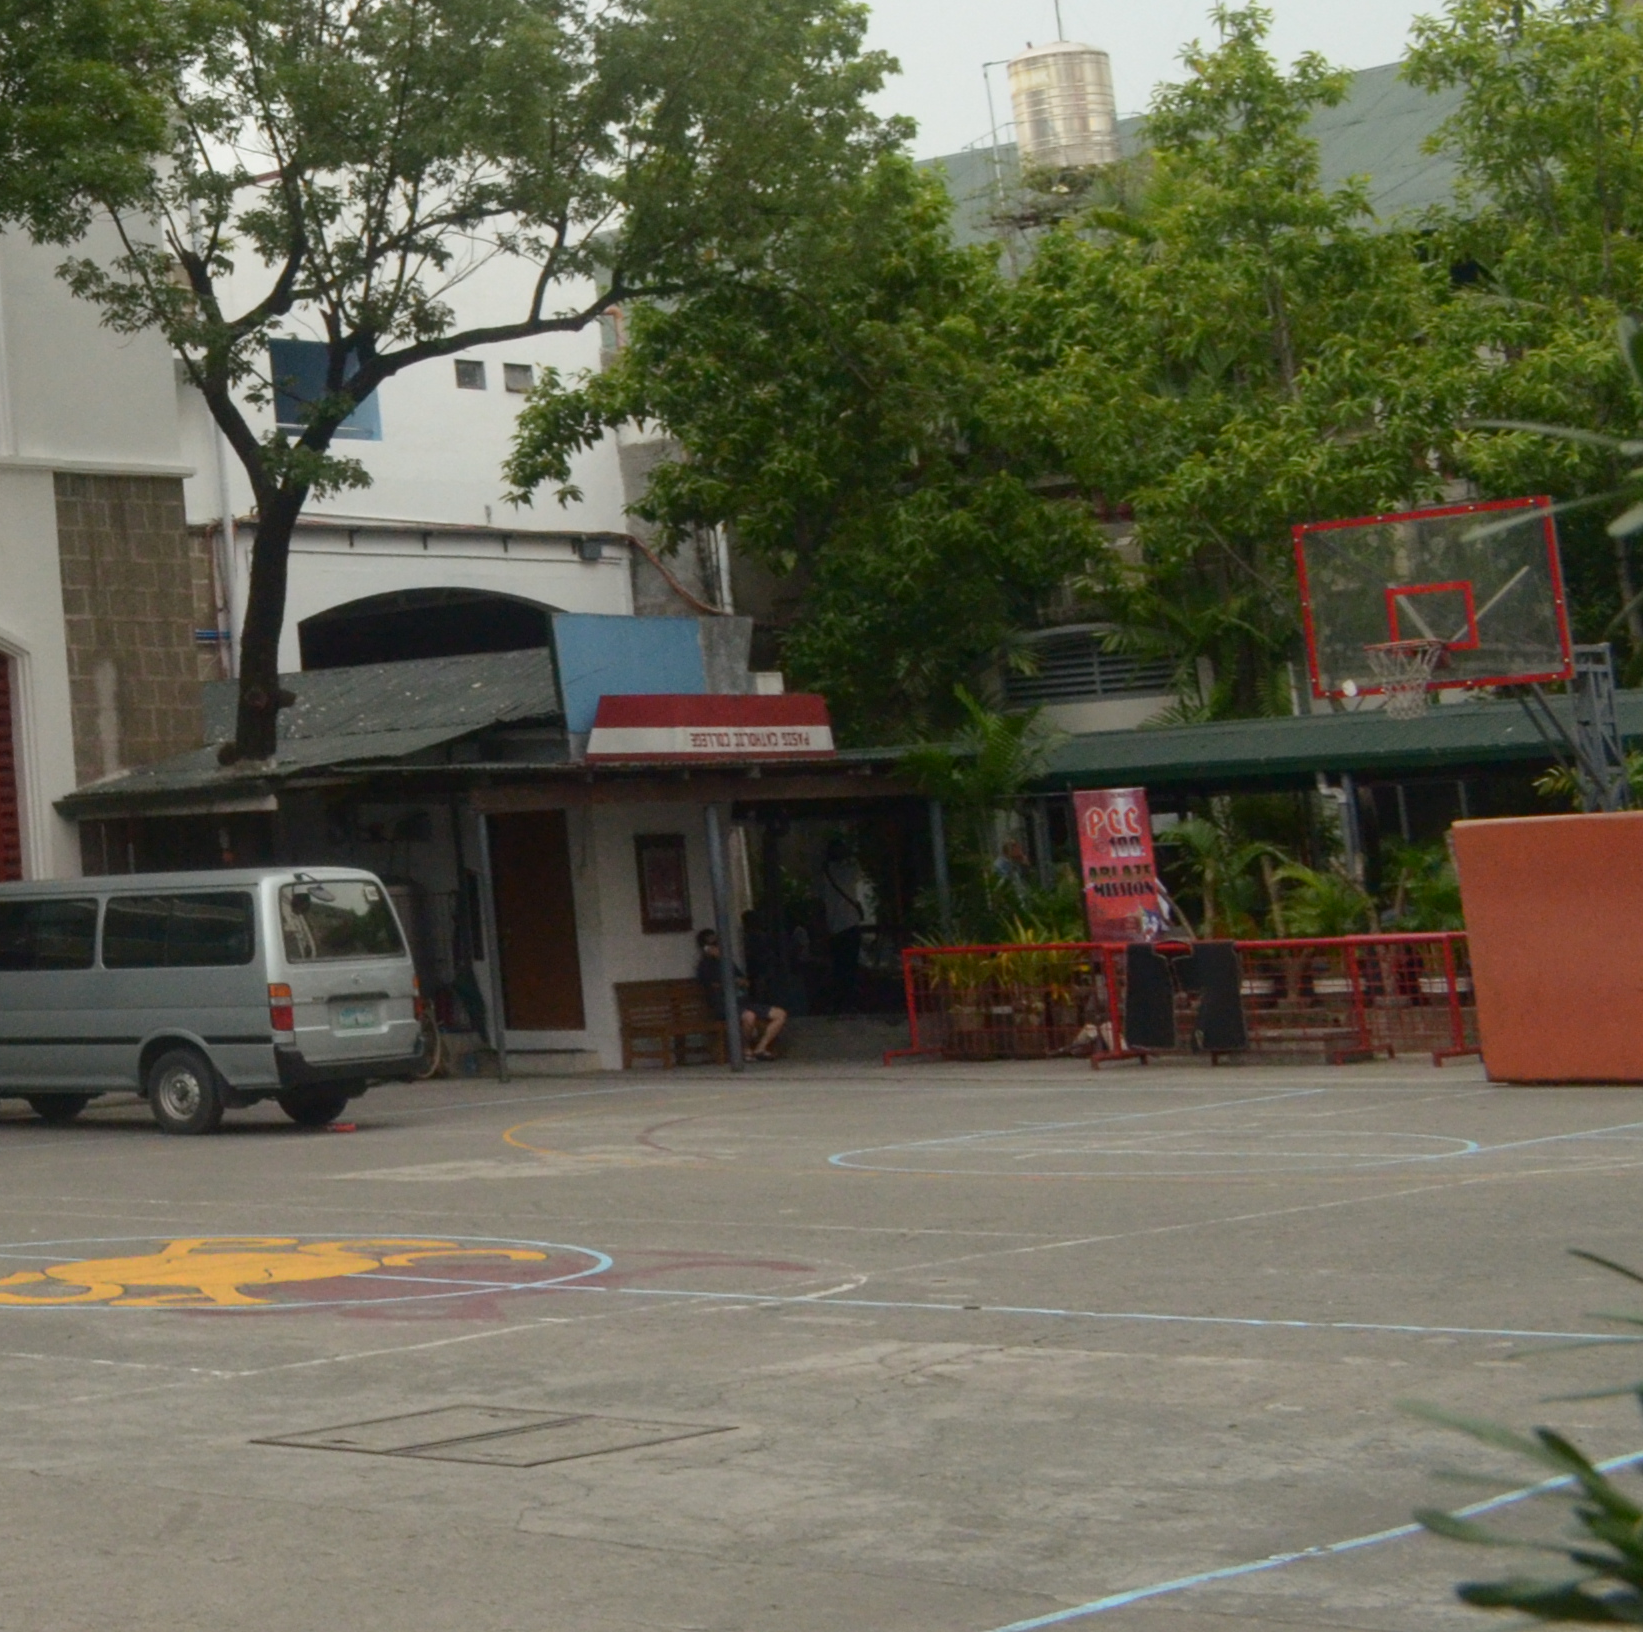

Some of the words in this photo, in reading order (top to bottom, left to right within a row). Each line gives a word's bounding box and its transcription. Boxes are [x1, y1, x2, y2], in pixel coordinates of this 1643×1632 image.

[689, 732, 731, 747] COLLEGE
[733, 732, 779, 747] CATHOLIC
[1086, 806, 1143, 839] PCC
[1093, 881, 1157, 898] MISSION
